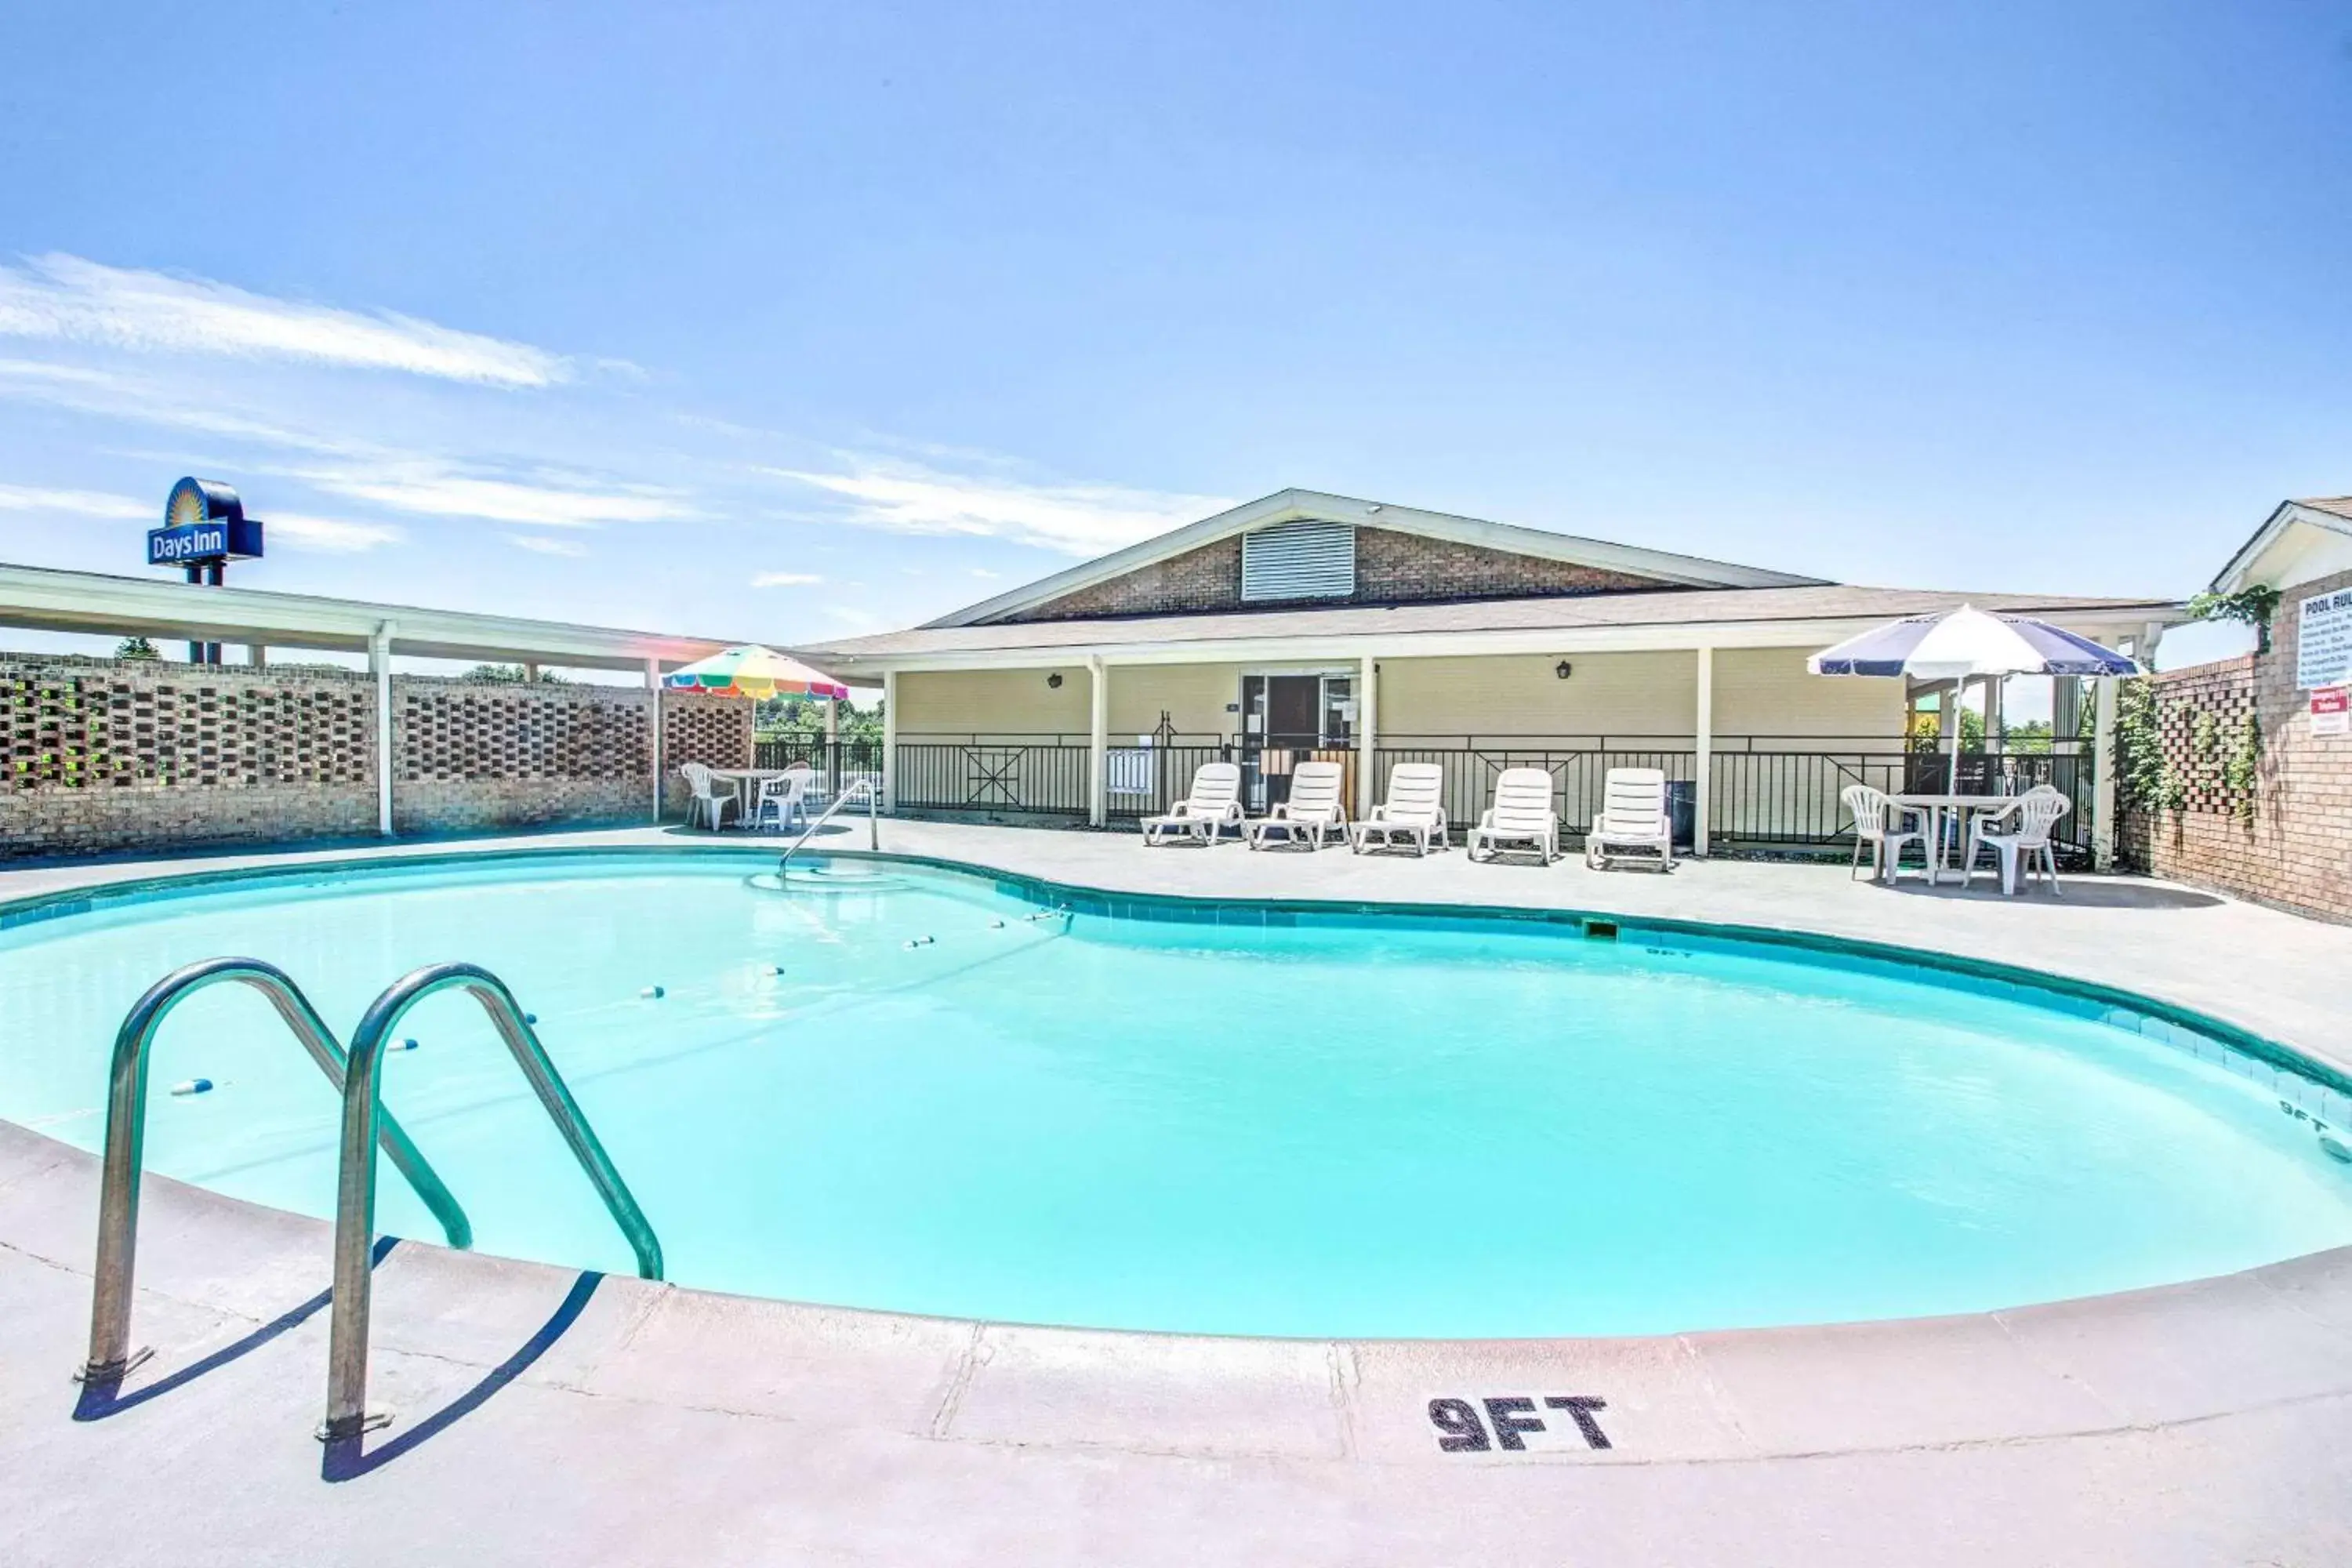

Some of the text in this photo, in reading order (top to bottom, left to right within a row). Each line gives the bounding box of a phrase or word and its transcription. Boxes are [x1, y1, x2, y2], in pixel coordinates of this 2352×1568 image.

[153, 530, 222, 559] Days Inn
[2306, 598, 2330, 615] POOL
[1428, 1396, 1612, 1452] 9FT
